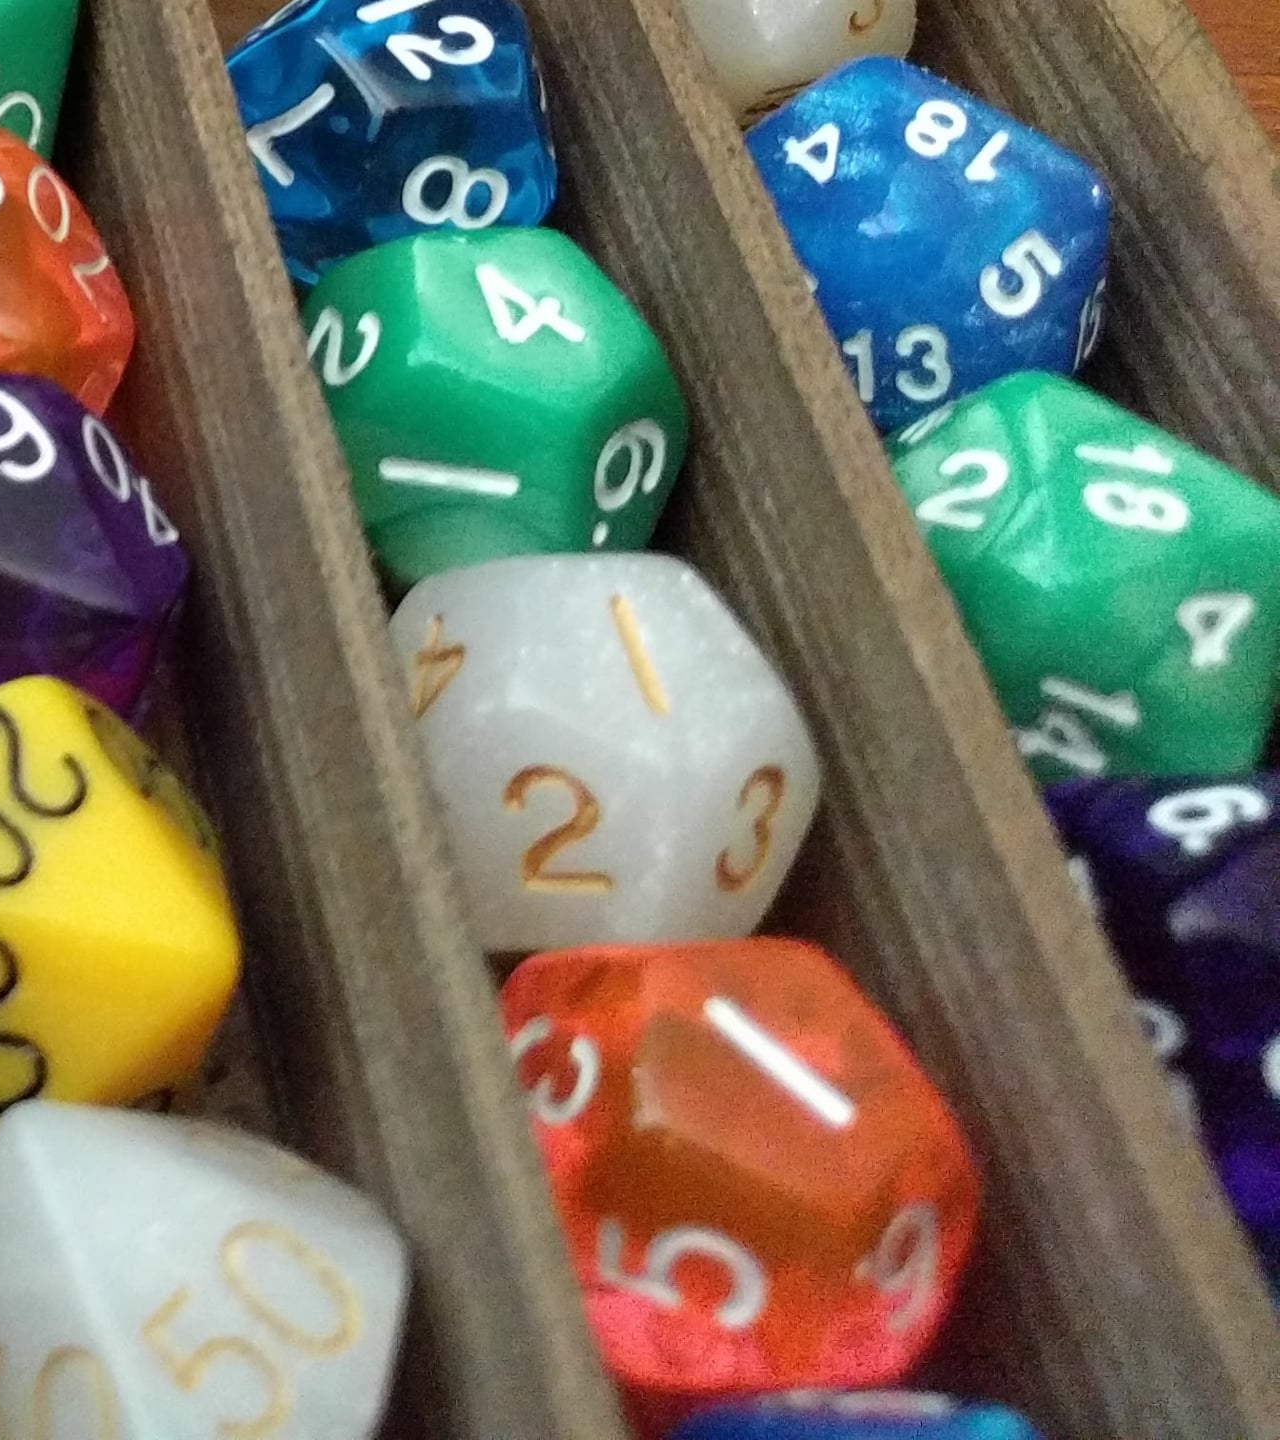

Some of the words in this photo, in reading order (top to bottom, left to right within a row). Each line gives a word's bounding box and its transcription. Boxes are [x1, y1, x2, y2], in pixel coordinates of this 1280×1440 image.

[782, 123, 839, 184] 4
[905, 100, 1010, 183] 18
[402, 155, 509, 230] 8
[475, 263, 586, 344] 4
[980, 228, 1063, 318] 5
[307, 306, 382, 386] 2
[843, 323, 952, 403] 13
[915, 449, 1010, 531] 2
[1074, 443, 1190, 533] 18
[609, 593, 671, 717] 1
[1176, 593, 1254, 667] 4
[1018, 676, 1140, 774] 14
[503, 764, 613, 892] 2
[715, 764, 786, 892] 3
[703, 996, 854, 1129] 1
[599, 1219, 767, 1329] 5
